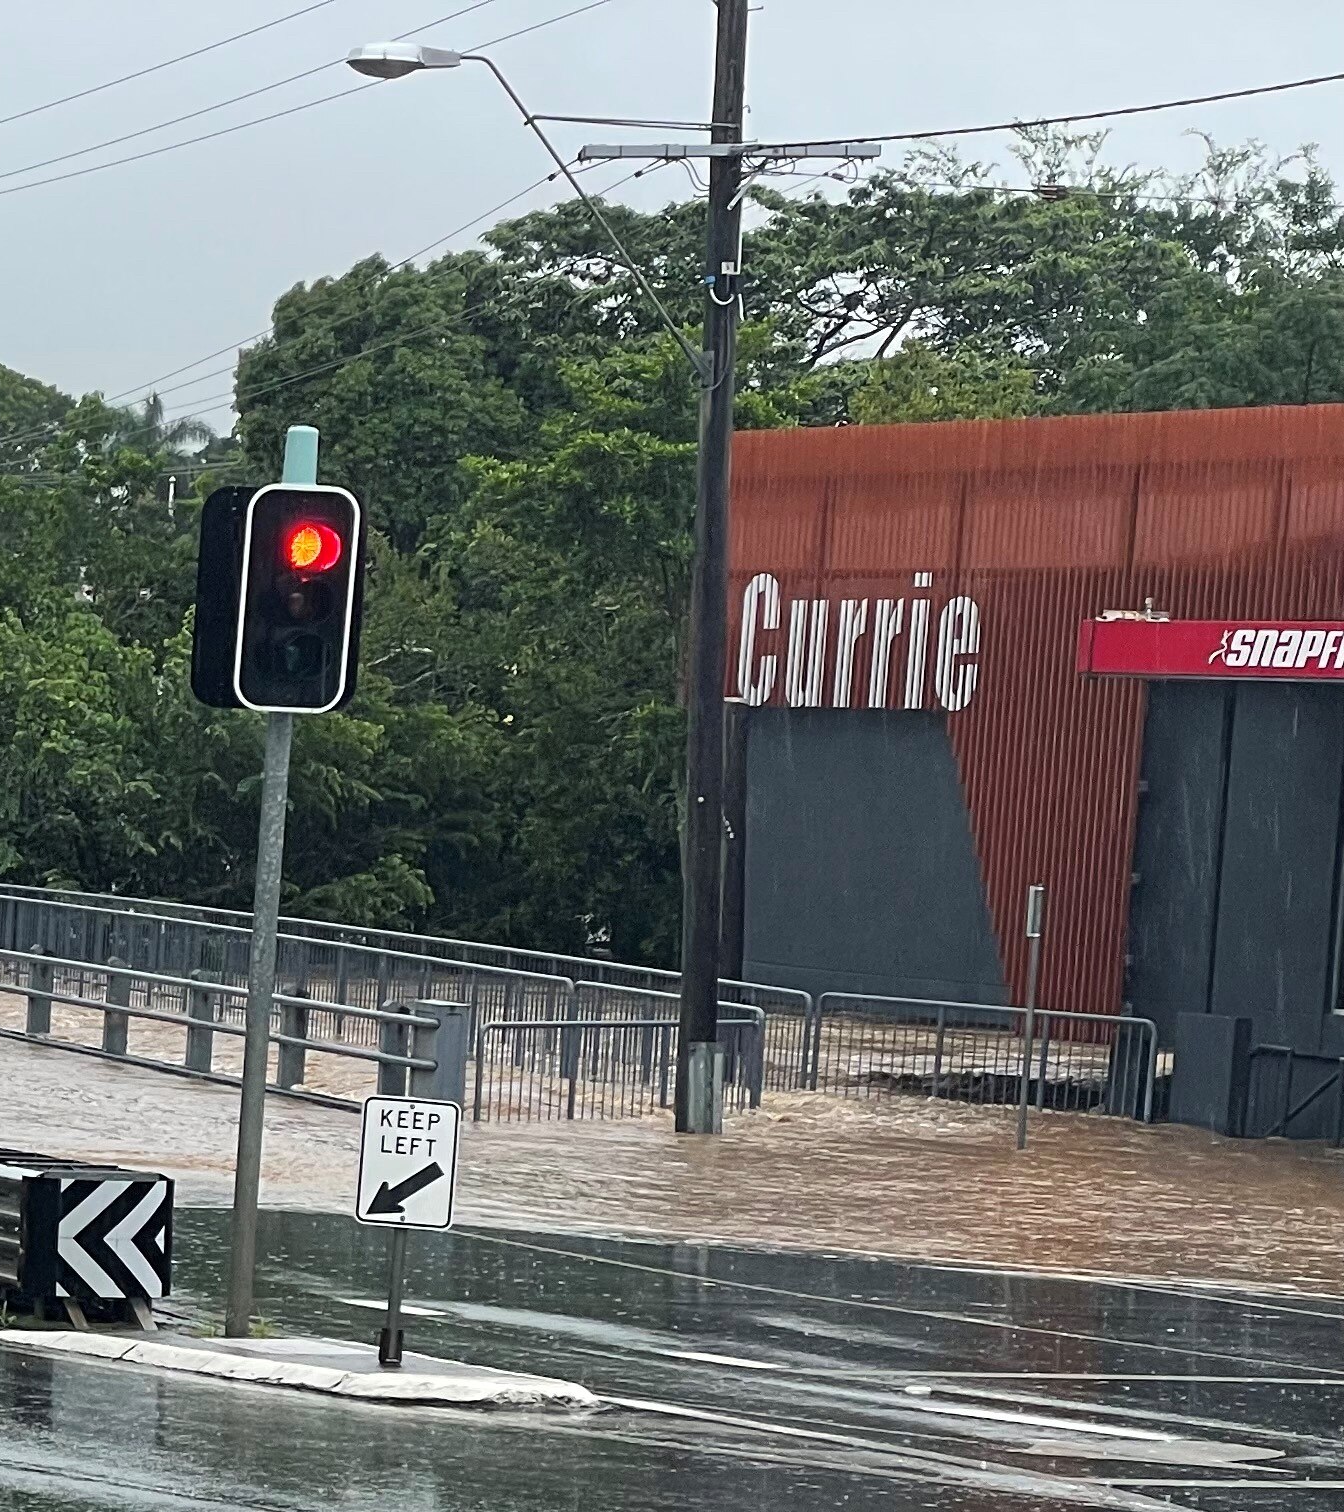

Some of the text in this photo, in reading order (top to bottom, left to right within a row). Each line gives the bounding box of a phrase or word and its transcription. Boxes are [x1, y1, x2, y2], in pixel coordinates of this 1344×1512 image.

[737, 572, 982, 712] Currie
[380, 1109, 441, 1131] KEEP
[380, 1135, 437, 1157] LEFT
